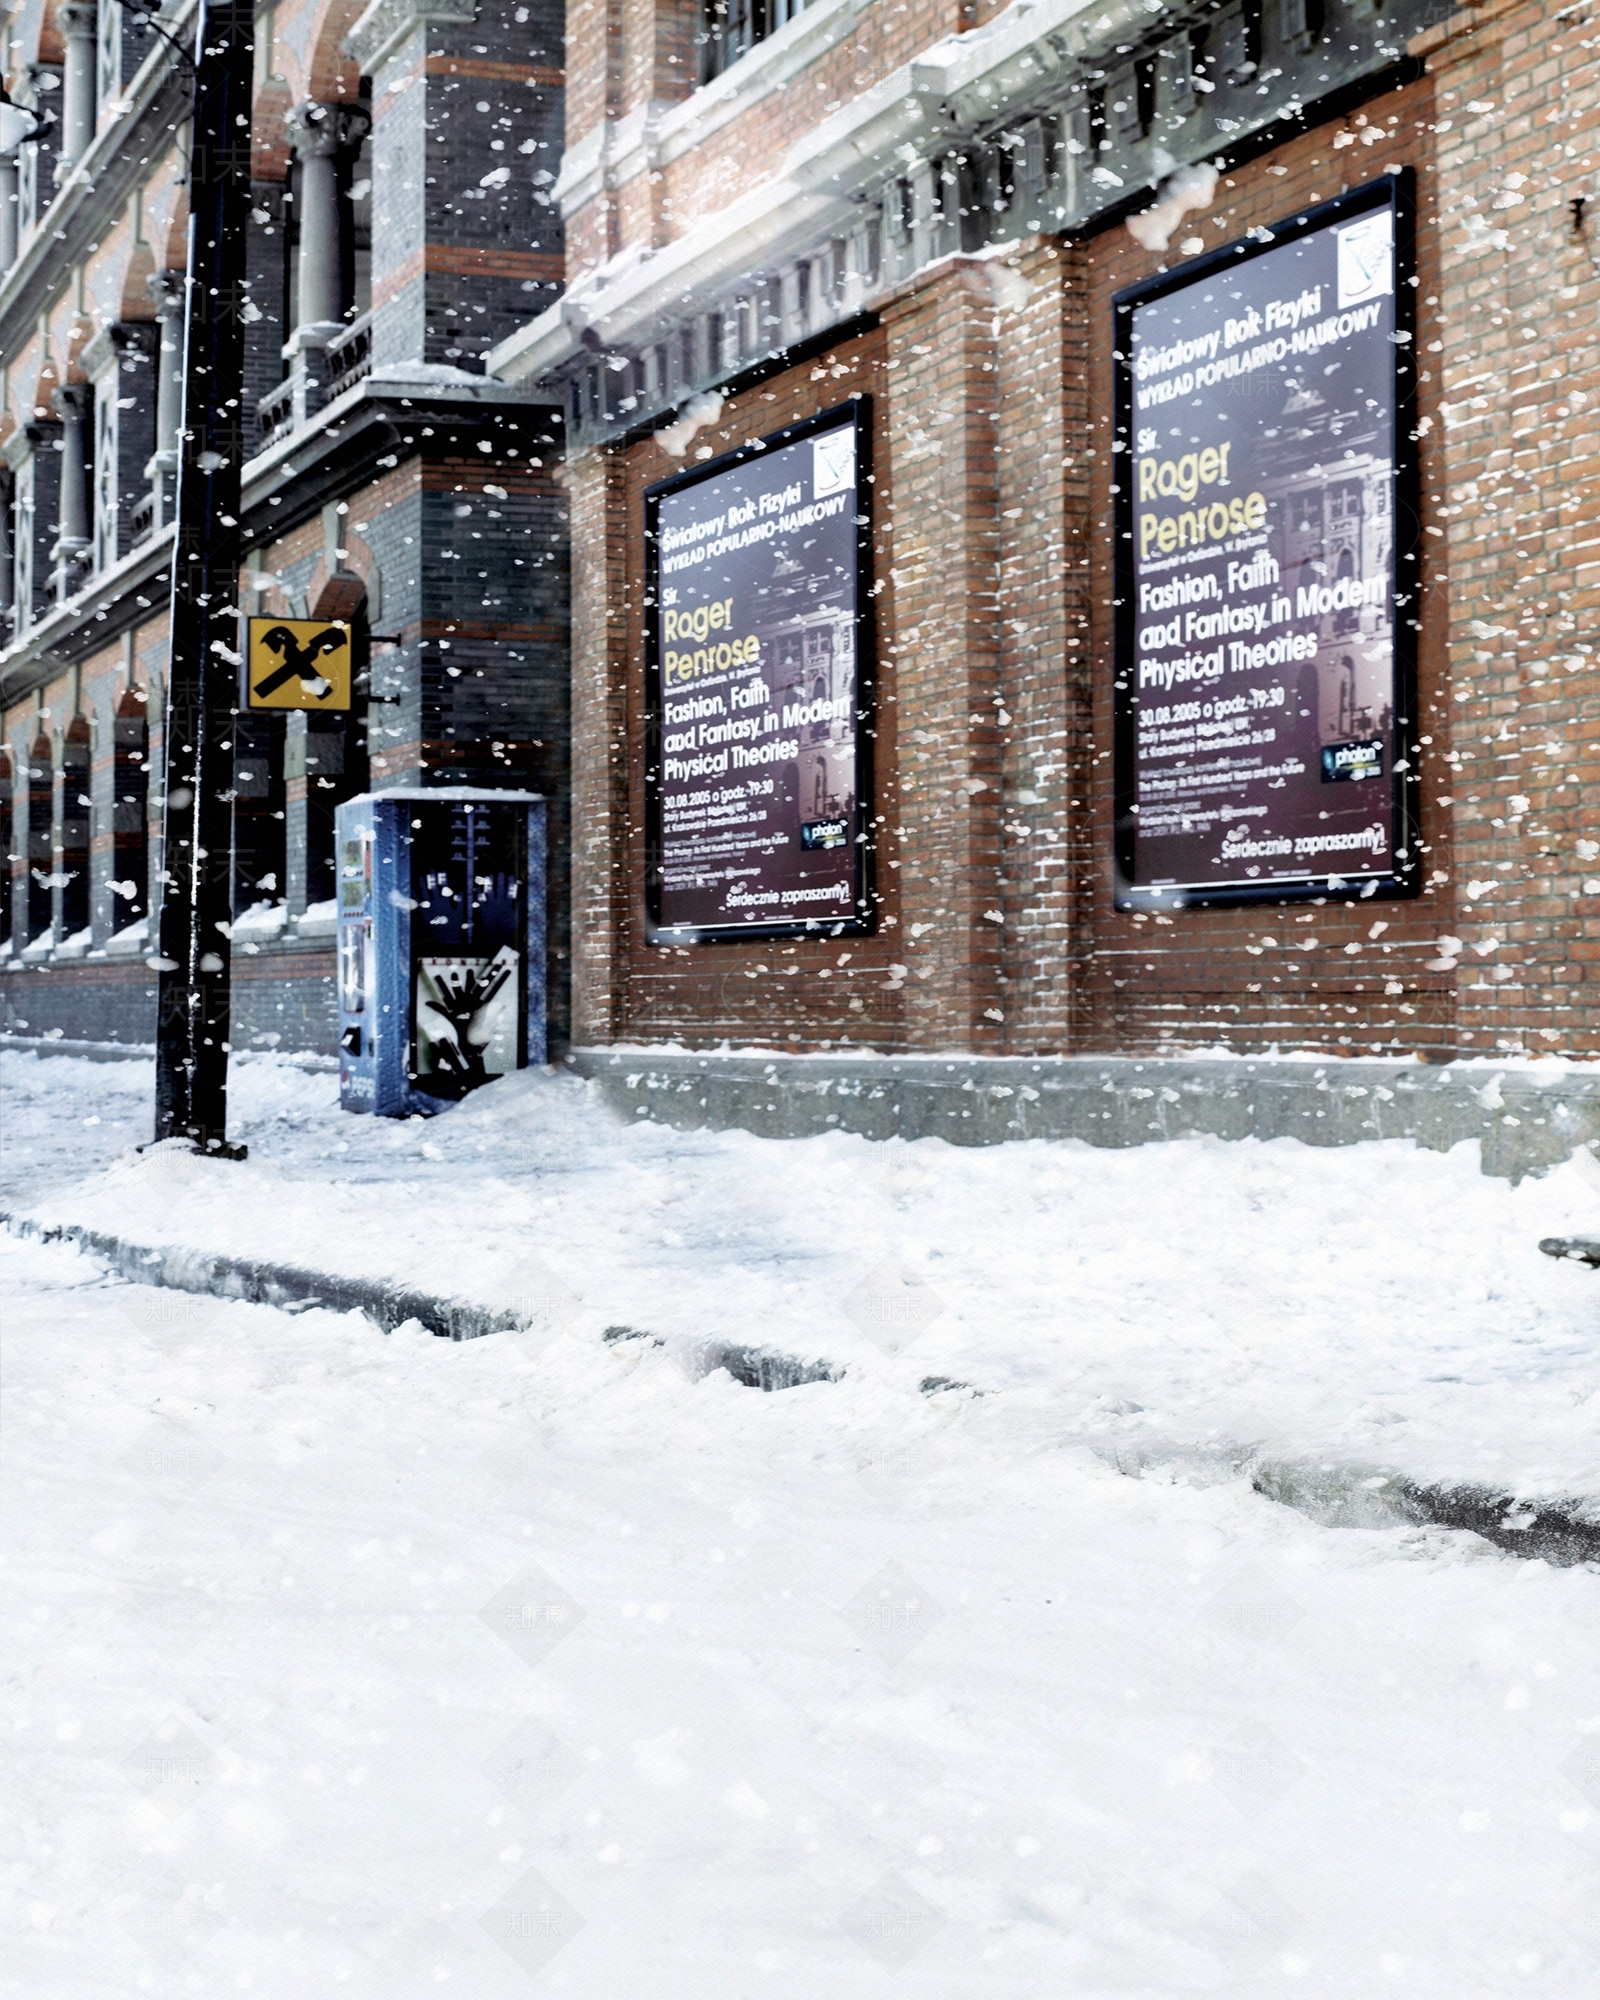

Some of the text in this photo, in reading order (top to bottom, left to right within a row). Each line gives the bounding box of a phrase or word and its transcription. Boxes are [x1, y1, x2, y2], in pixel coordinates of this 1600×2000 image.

[1136, 285, 1321, 382] Światowy Rok Fizyki
[1137, 303, 1382, 410] WYKŁAD POPULARNO-NAUKOWY
[1137, 428, 1157, 454] Sir
[1139, 441, 1231, 502] Roger
[662, 481, 801, 553] Światowy Rok Fizyki
[662, 495, 847, 574] WYKŁAD POPULARNO-NAUKOWY
[1140, 491, 1267, 558] Penrose
[662, 587, 677, 607] Sir
[1140, 555, 1280, 613] Fashion, Faith
[664, 597, 733, 642] Roger
[1139, 576, 1387, 651] and Fantasy in Modern
[665, 634, 760, 684] Penrose
[1139, 630, 1318, 691] Physical Theories
[664, 697, 851, 753] and Fantasy in Modern
[665, 682, 770, 725] Fashion, Faith
[1138, 702, 1201, 728] 30.08.2005
[664, 737, 799, 782] Physical Theories
[1335, 746, 1376, 768] photon
[663, 791, 711, 810] 30.08.2005
[811, 823, 842, 839] photon
[1221, 826, 1386, 859] Serdecznie zapraszamy!
[726, 889, 780, 907] Serdecznie
